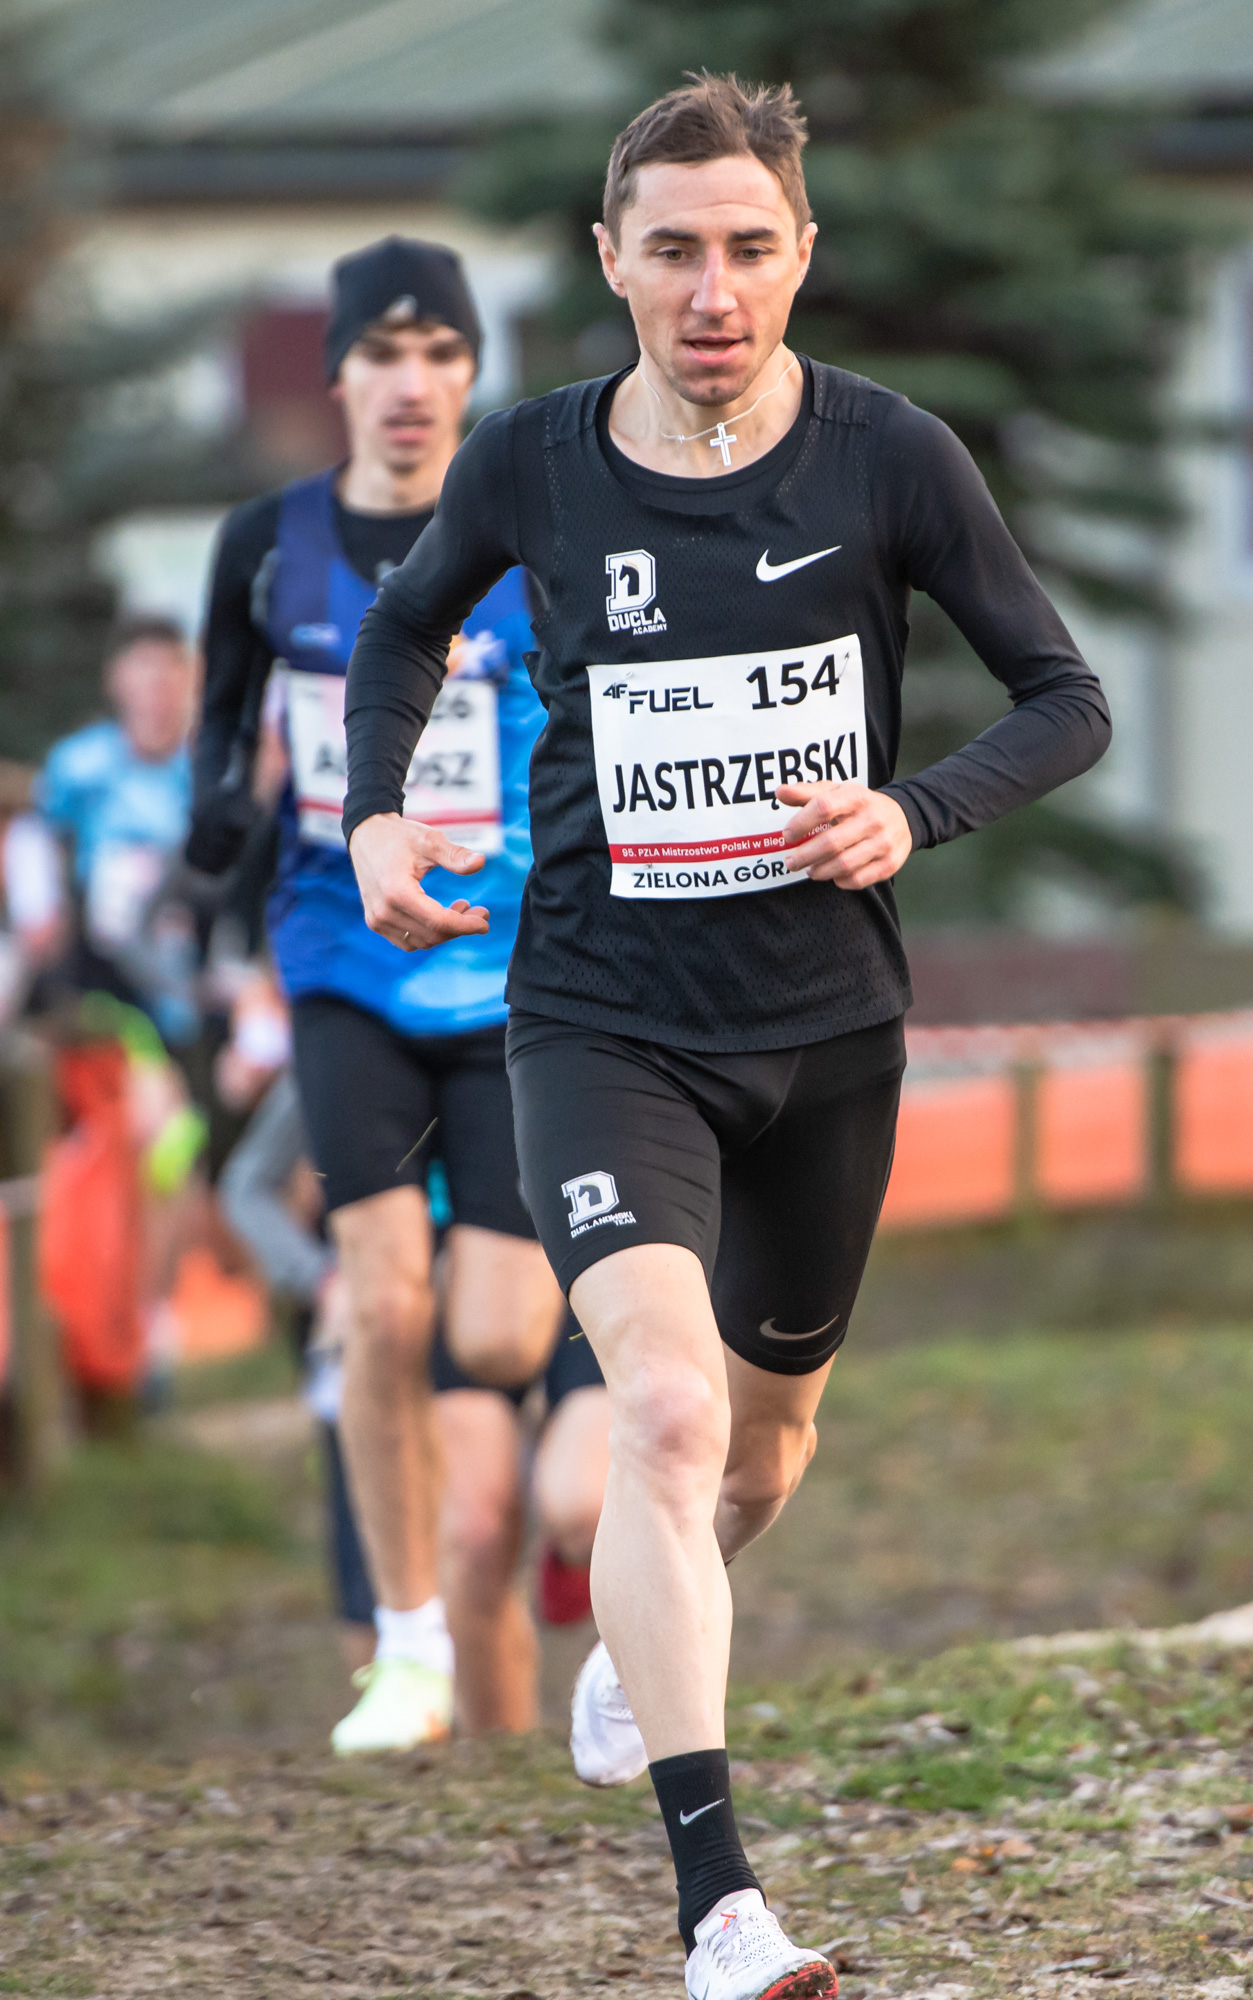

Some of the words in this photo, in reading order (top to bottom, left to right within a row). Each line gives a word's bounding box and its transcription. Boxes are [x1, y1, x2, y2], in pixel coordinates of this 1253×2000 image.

[607, 607, 667, 632] DUCLA
[632, 622, 668, 636] ACADEMY
[746, 654, 840, 711] 154
[628, 686, 715, 714] FUEL
[612, 730, 858, 813] JASTRZĘBSKI
[622, 847, 637, 857] 95.
[638, 847, 660, 857] PZLA
[661, 845, 720, 857] Mistrzostwa
[721, 839, 751, 853] Polski
[752, 840, 761, 849] w
[763, 836, 785, 848] Bieg
[633, 869, 729, 889] ZIELONA
[734, 858, 791, 882] GÓR
[570, 1210, 634, 1239] DUKLANOWSKI
[614, 1216, 637, 1227] TEAM
